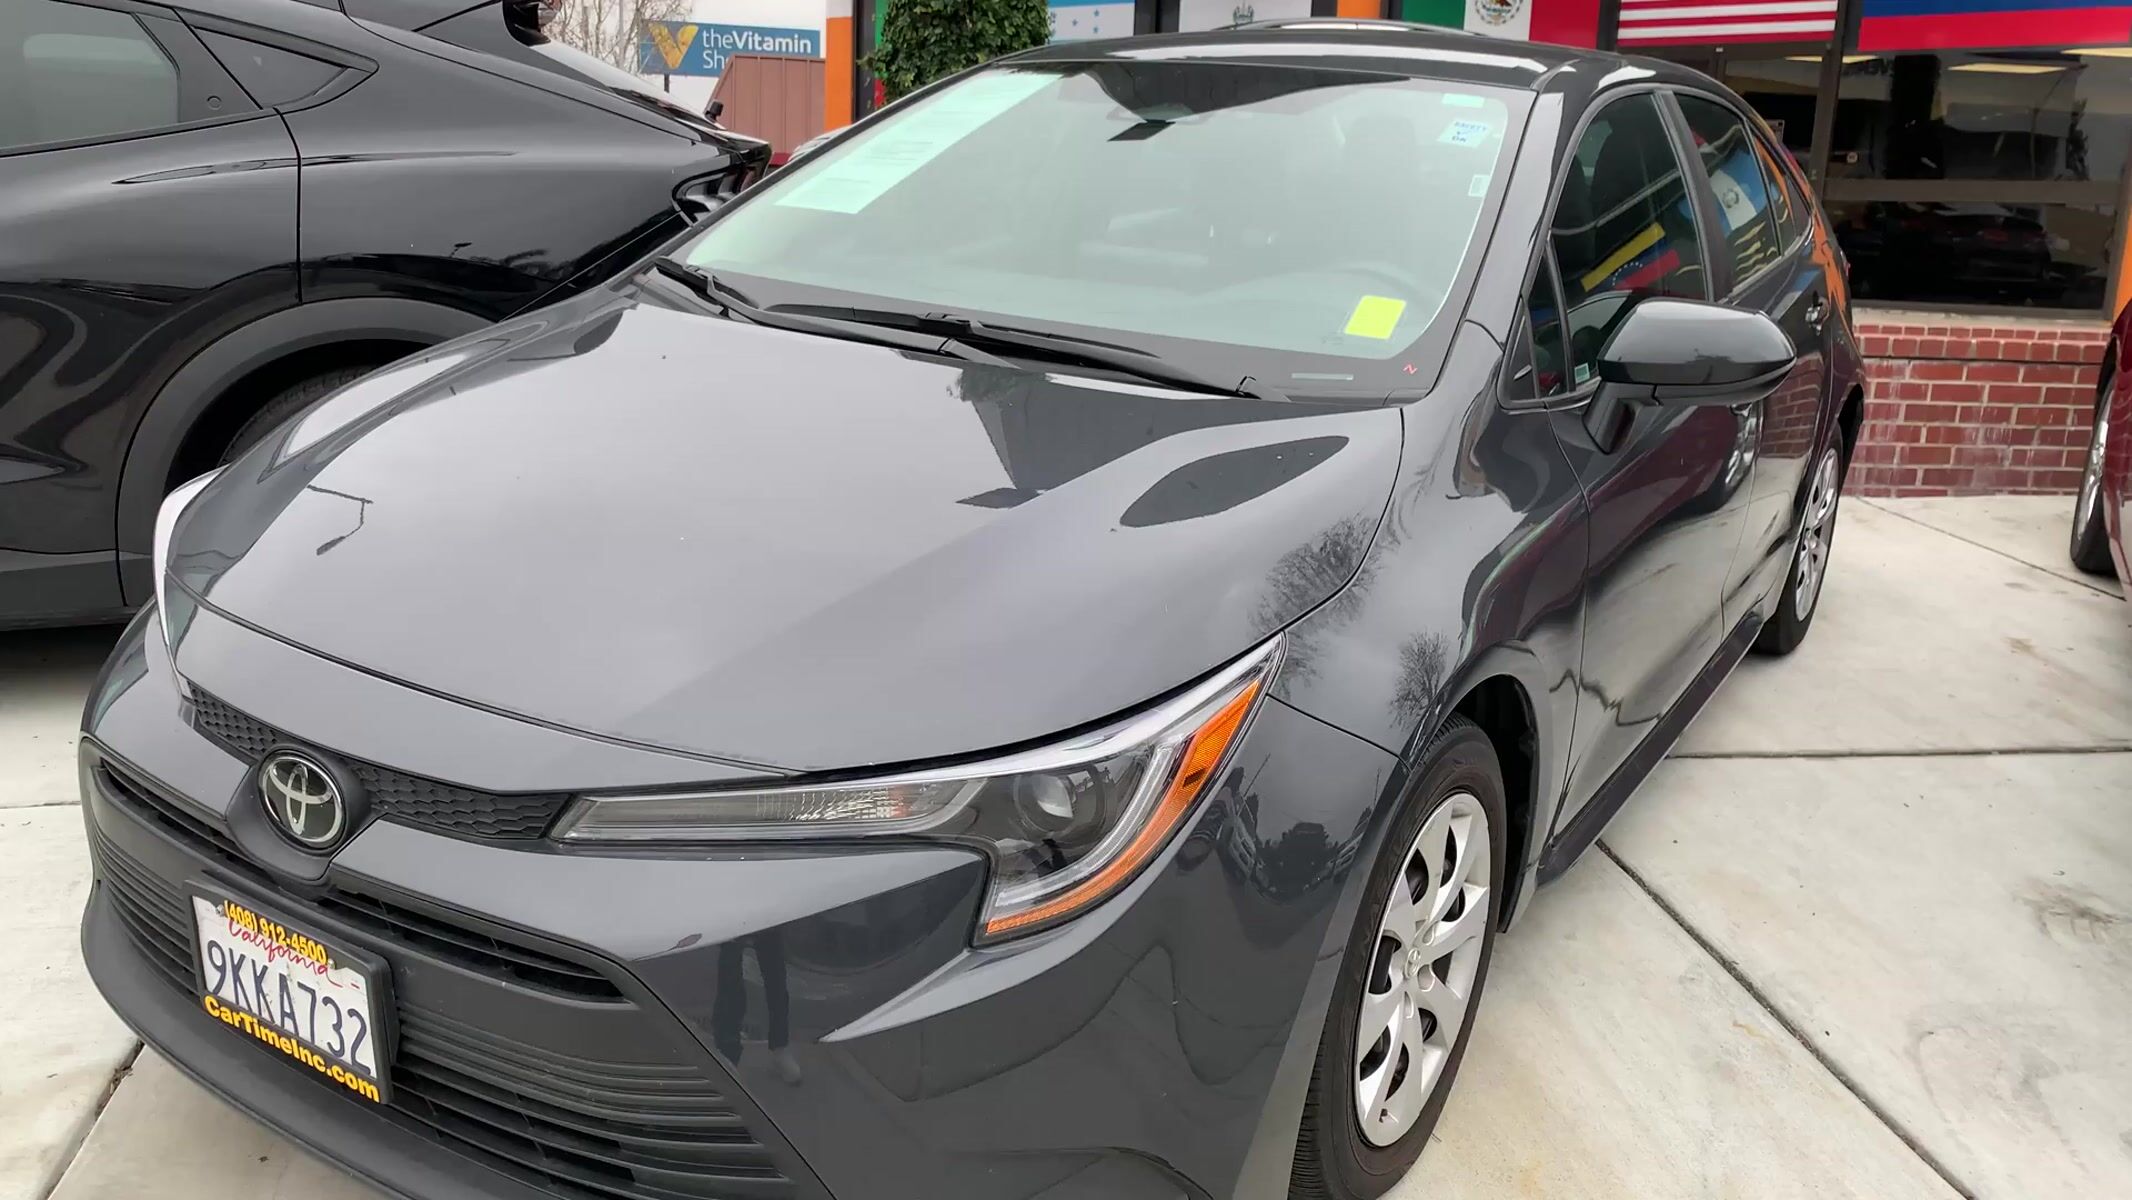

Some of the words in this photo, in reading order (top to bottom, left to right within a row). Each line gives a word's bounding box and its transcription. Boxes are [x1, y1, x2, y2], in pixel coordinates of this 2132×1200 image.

[703, 29, 811, 53] theVitamin
[703, 50, 729, 69] Sh
[224, 899, 258, 934] (408)
[207, 939, 371, 1075] 9KKA732
[204, 994, 380, 1103] CarTimeInc.com
